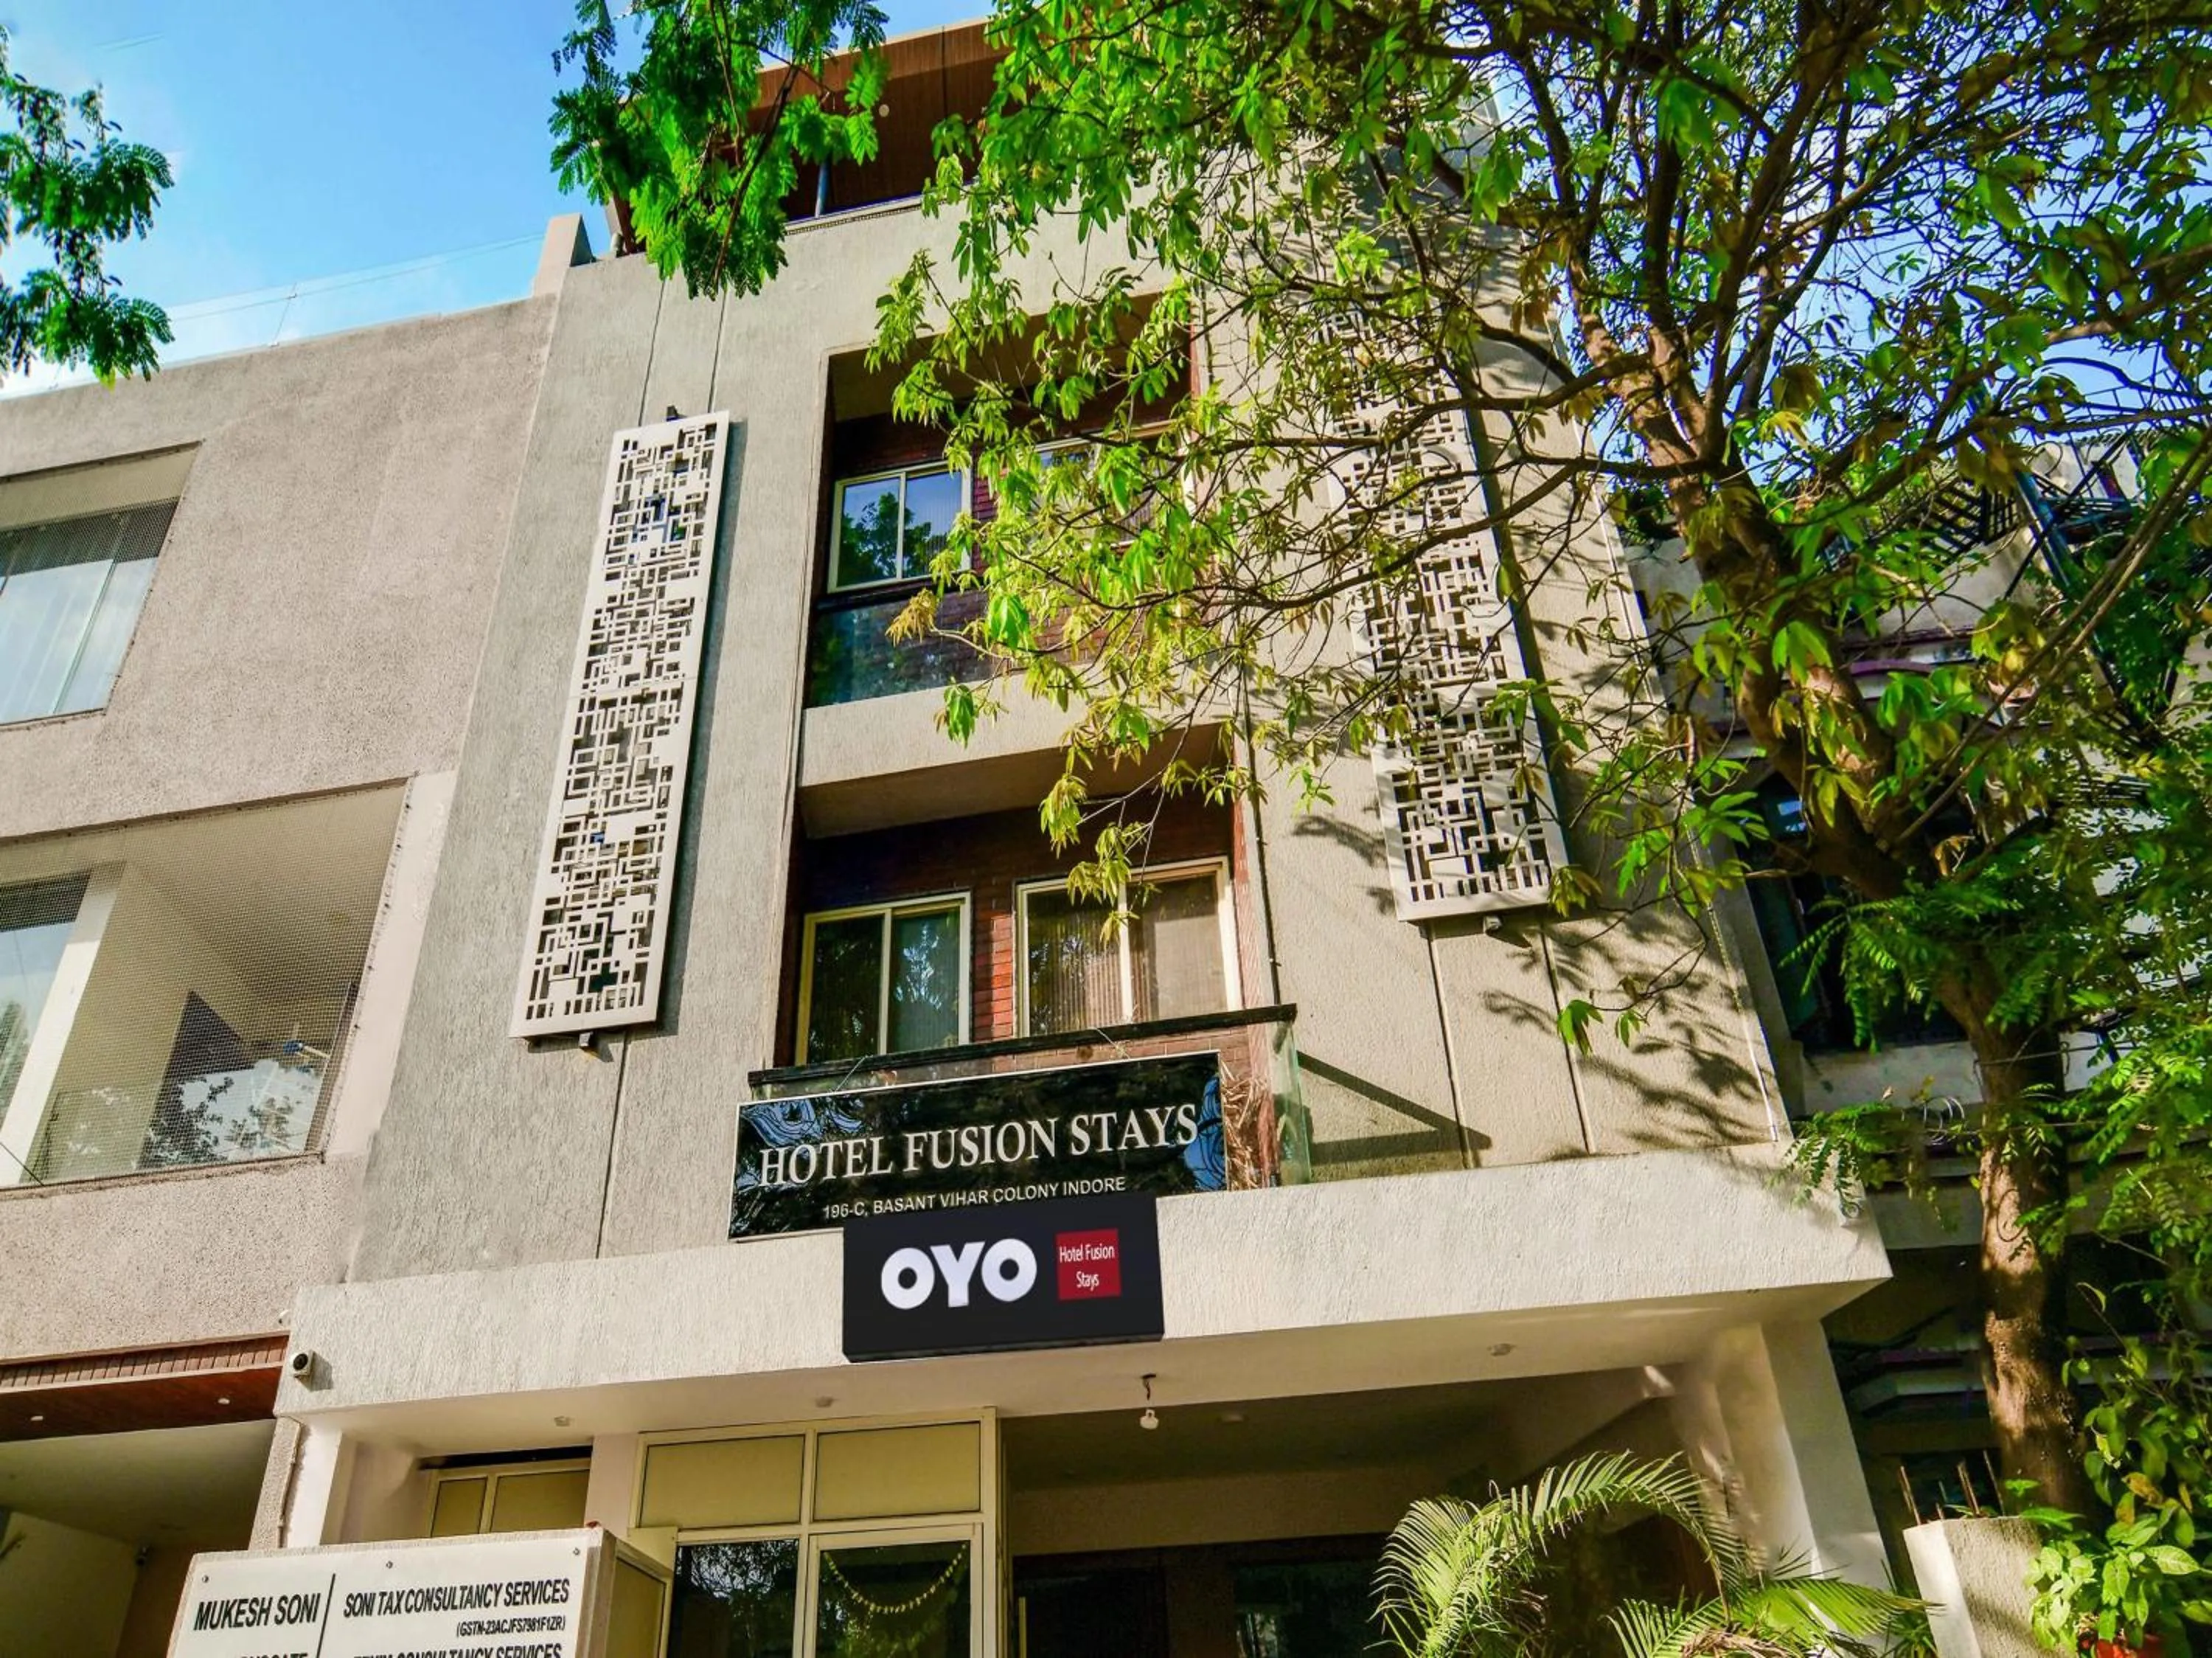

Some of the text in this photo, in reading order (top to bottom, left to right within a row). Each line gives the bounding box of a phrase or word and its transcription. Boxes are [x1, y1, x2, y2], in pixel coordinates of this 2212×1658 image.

[758, 1103, 1198, 1187] HOTEL FUSION STAYS
[823, 1177, 1126, 1219] 196-C, BASANT VIHAR COLONY INDORE
[1059, 1244, 1116, 1263] Hotel Fusion
[881, 1238, 1037, 1310] OYO
[1076, 1270, 1100, 1291] Stays
[193, 1592, 321, 1631] MUKESH SONI
[343, 1578, 570, 1617] SONI TAX CONSULTANCY SERVICES
